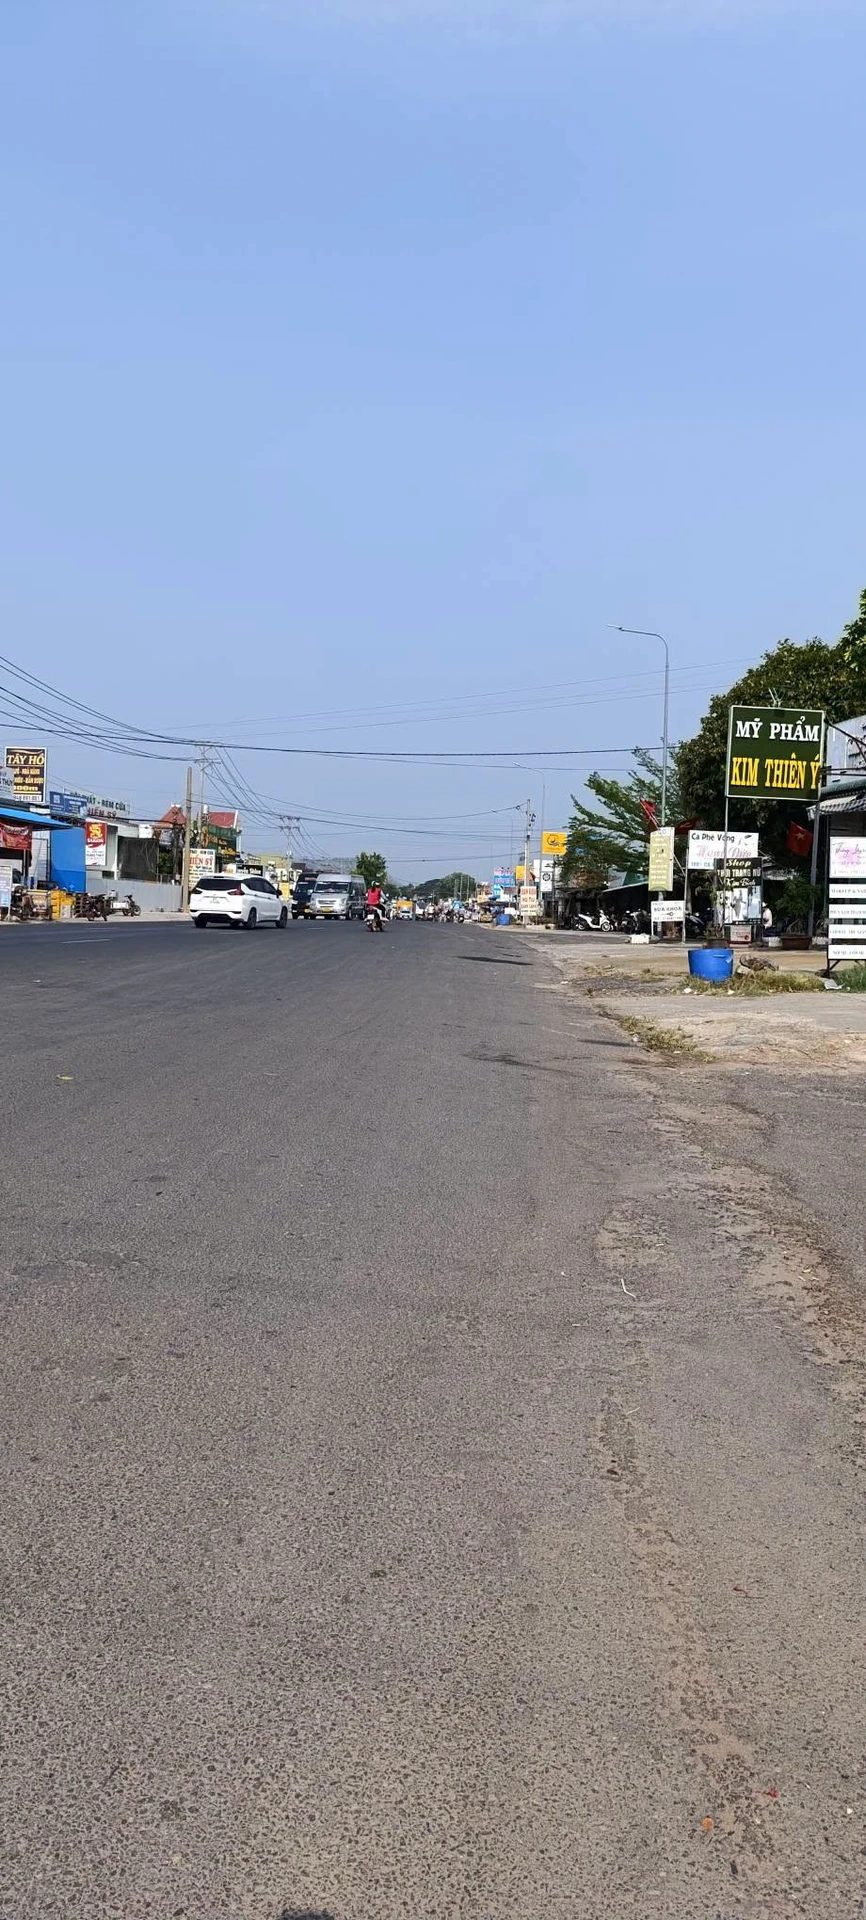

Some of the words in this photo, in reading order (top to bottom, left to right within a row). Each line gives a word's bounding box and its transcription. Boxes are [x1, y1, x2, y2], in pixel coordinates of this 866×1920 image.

[735, 718, 763, 738] MỸ
[769, 716, 819, 742] PHẨM
[7, 753, 27, 765] TÂY
[731, 757, 760, 786] KIM
[764, 752, 807, 789] THIÊN
[810, 753, 820, 789] Ý
[726, 858, 752, 868] Shop
